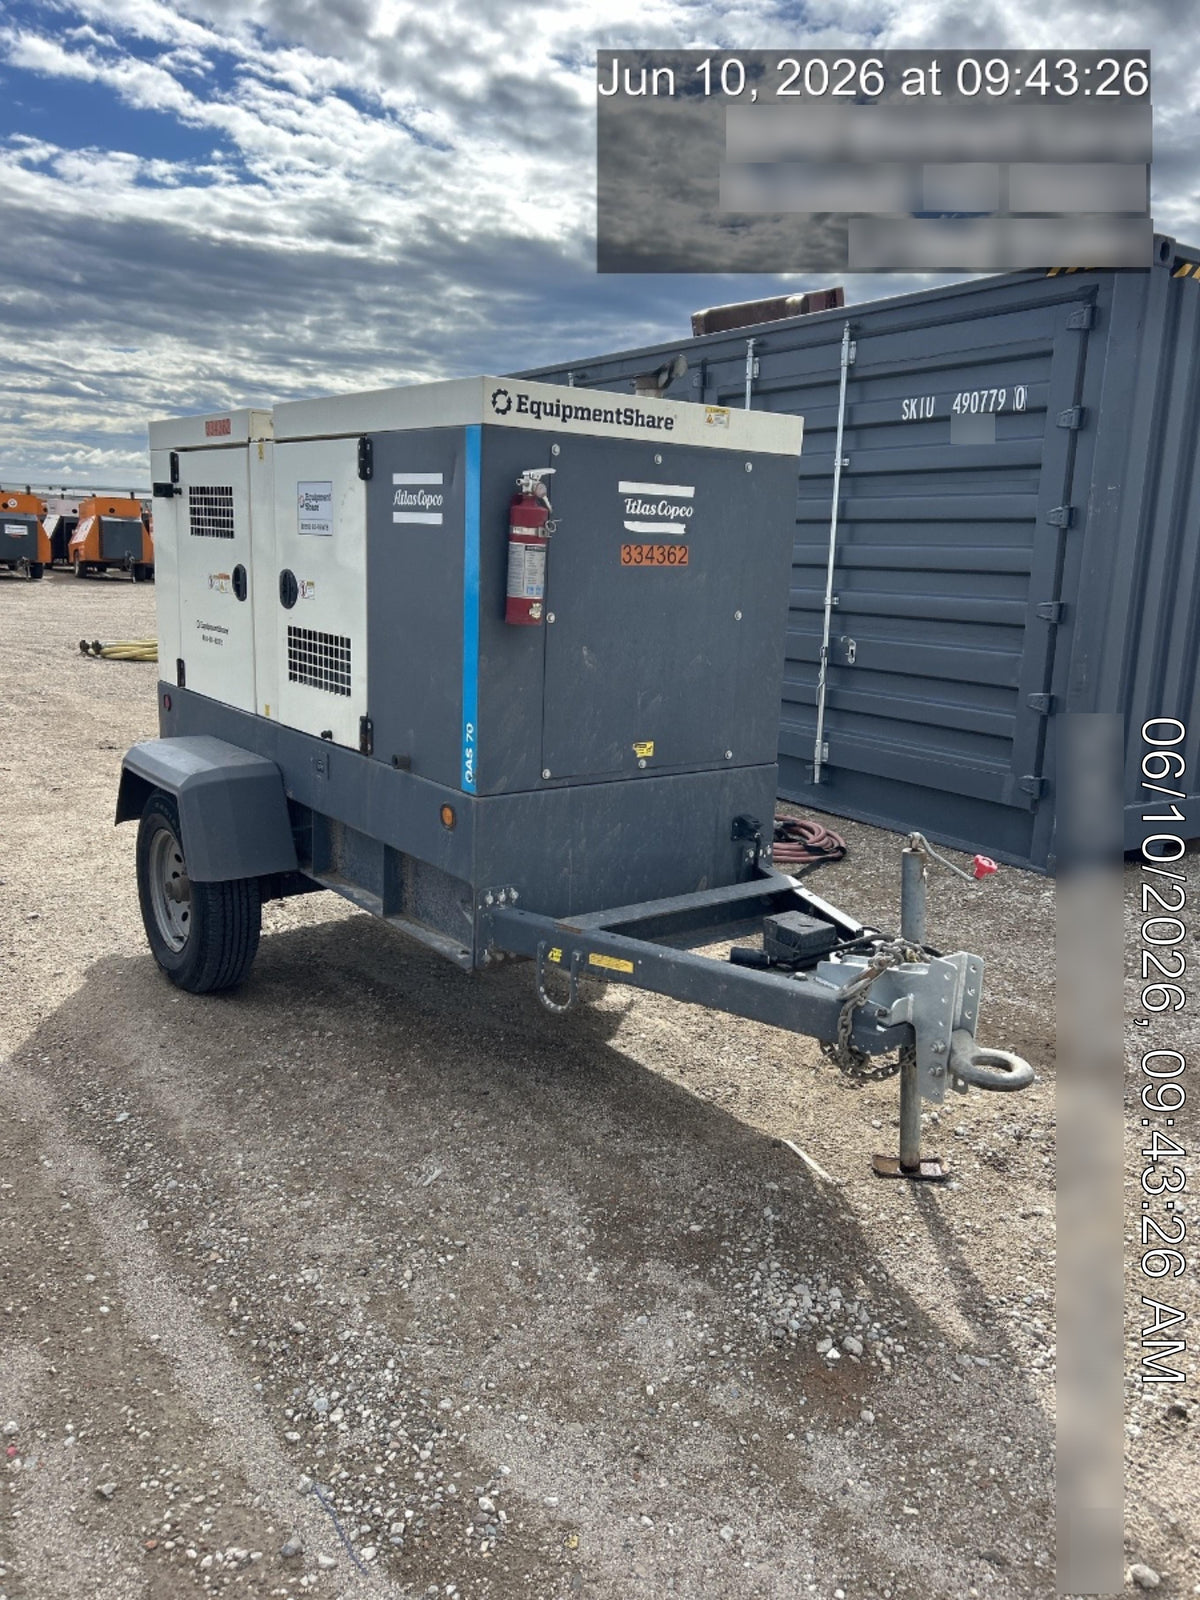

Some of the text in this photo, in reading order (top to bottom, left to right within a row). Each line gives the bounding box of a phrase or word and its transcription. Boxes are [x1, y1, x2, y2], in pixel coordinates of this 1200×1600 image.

[515, 393, 675, 431] EquipmentShare
[901, 386, 1026, 420] SKIU 490779 0
[657, 499, 694, 519] Copco
[621, 544, 689, 564] 334362
[464, 722, 474, 784] QAS 70
